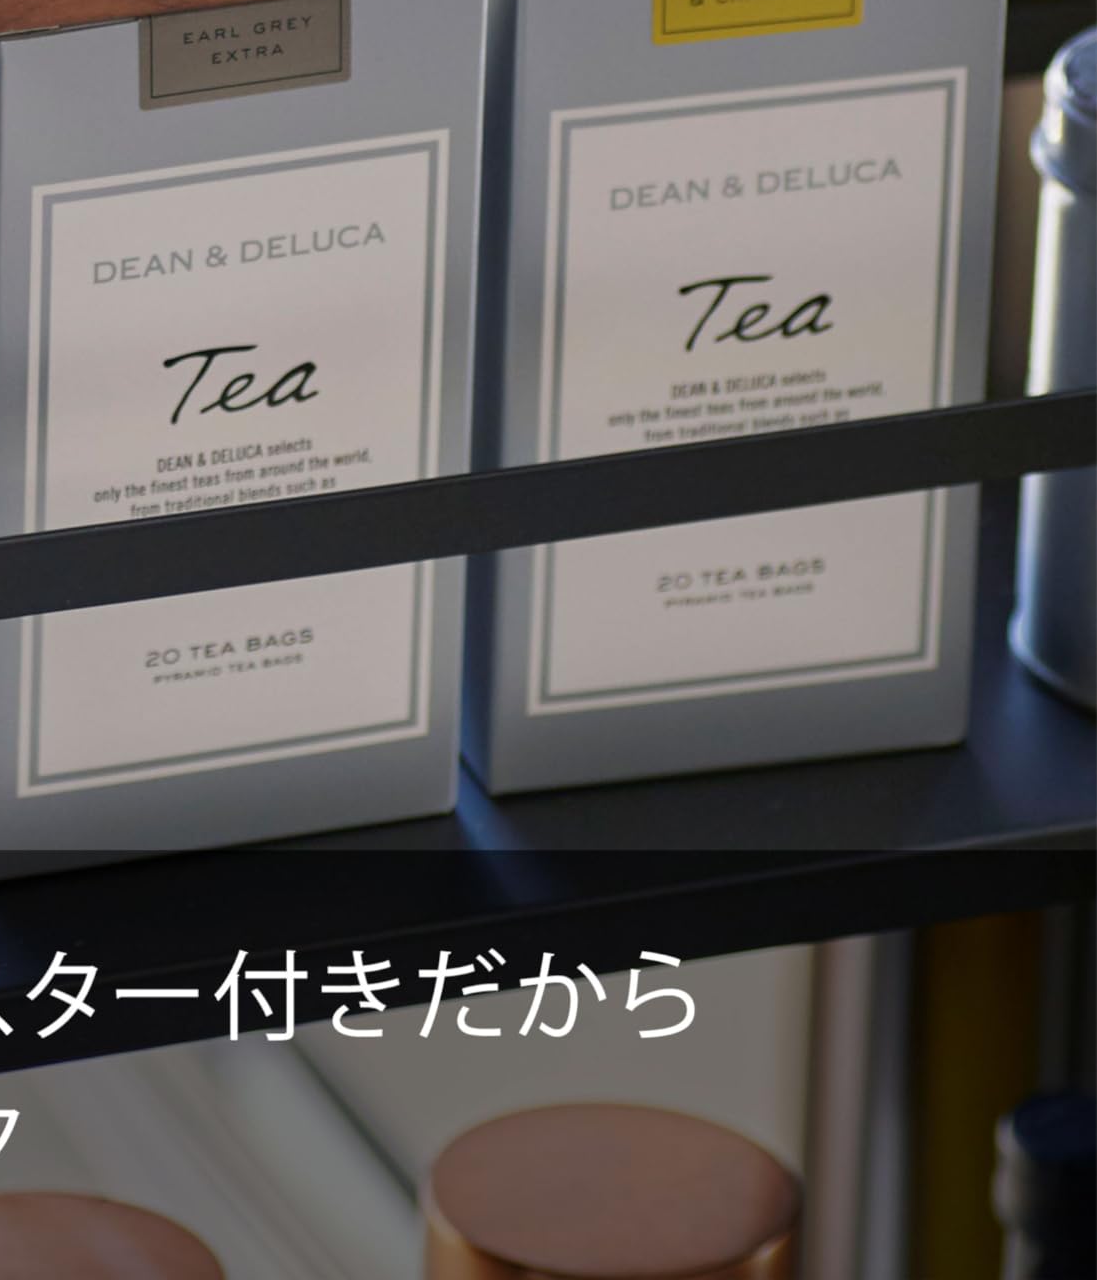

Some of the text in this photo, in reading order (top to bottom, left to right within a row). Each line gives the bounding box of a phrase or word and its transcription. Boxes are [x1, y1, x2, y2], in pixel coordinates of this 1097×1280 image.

[183, 15, 314, 45] EARL GREY
[211, 43, 285, 65] EXTRA
[609, 158, 902, 211] DEAN & DELUCA
[93, 222, 386, 285] DEAN & DELUCA
[678, 274, 834, 352] Tea
[163, 344, 319, 424] Tea
[672, 381, 707, 399] DEAN
[726, 373, 777, 392] DELUCA
[157, 437, 313, 473] DEAN & DELUCA selects
[93, 483, 121, 505] only
[125, 481, 146, 498] the
[150, 475, 188, 494] finest
[193, 472, 220, 489] teas
[224, 466, 255, 484] from
[259, 458, 304, 478] around
[308, 454, 329, 471] the
[130, 475, 336, 518] from traditional blends such as
[657, 557, 825, 592] 20 TEA BAGS
[145, 627, 314, 668] 20 TEA BAGS
[228, 661, 257, 673] TEA
[262, 653, 303, 669] BAGS
